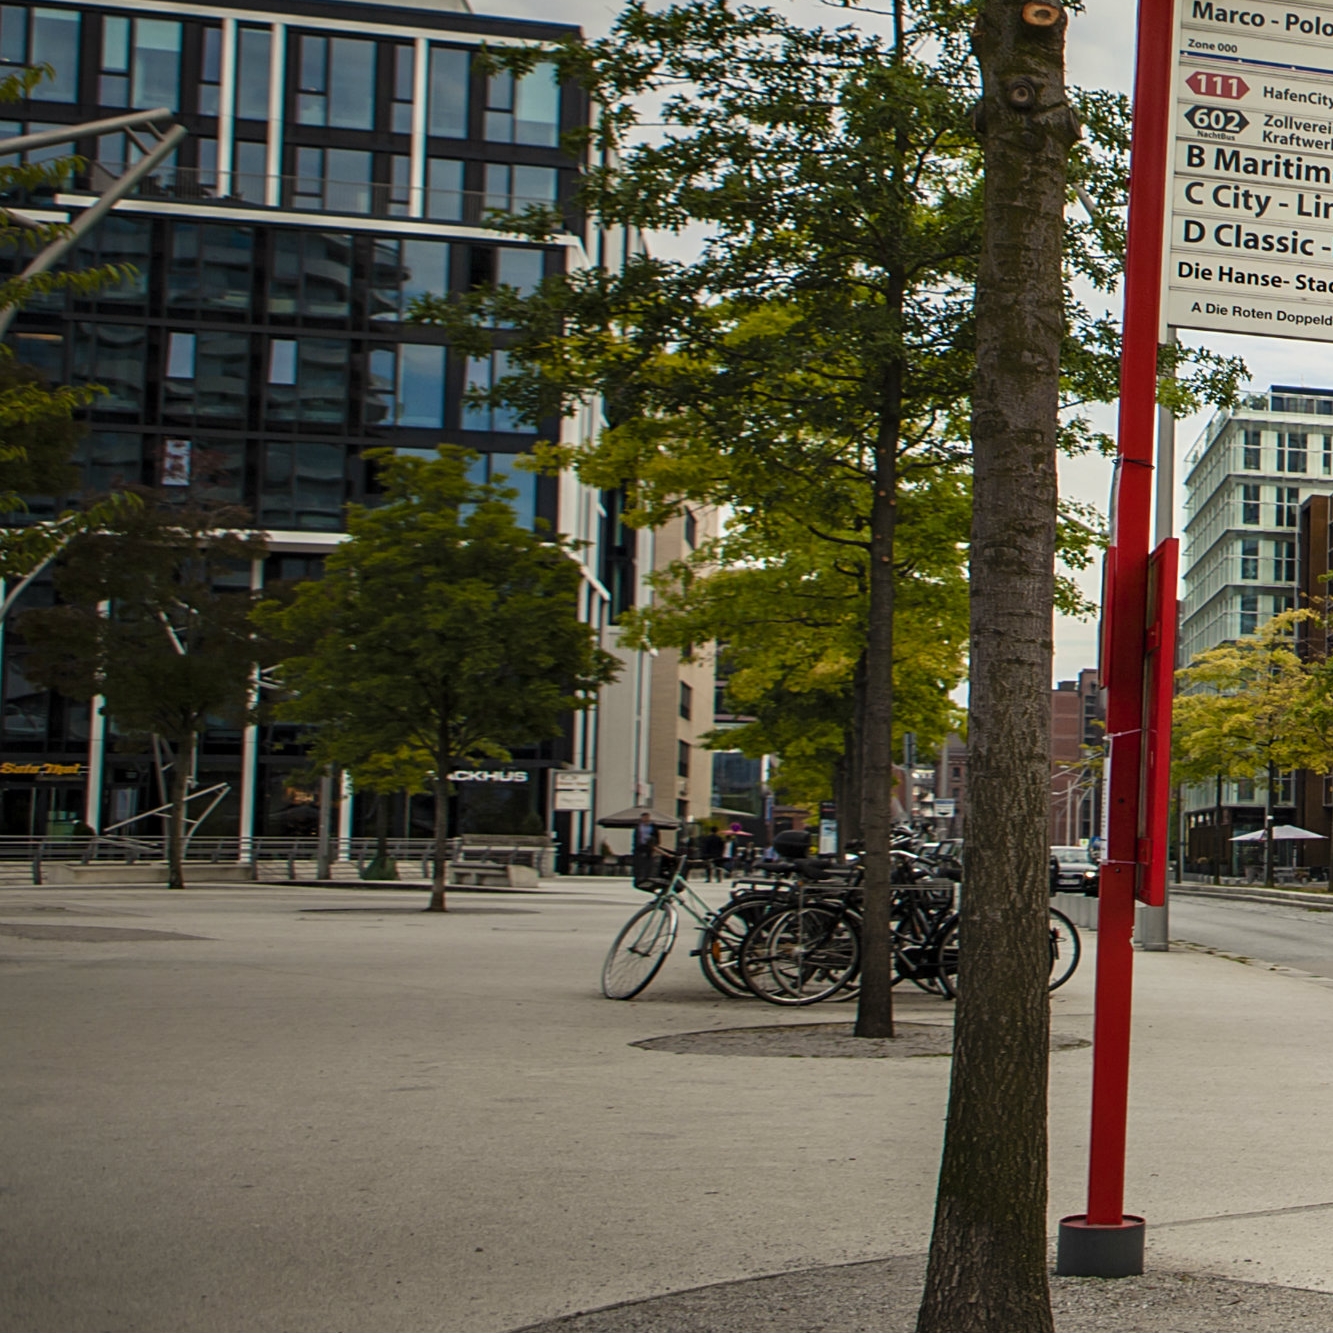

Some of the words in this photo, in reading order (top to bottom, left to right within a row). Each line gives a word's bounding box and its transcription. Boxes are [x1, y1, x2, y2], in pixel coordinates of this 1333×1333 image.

[1192, 0, 1265, 28] Marco
[1188, 39, 1215, 51] Zone
[1217, 42, 1238, 53] 000
[1197, 73, 1239, 97] 111
[1194, 109, 1241, 132] 602
[1197, 130, 1235, 142] NachtBus
[1187, 144, 1205, 168] B
[1185, 181, 1204, 205] C
[1212, 184, 1272, 217] City
[1184, 219, 1205, 243] D
[1214, 223, 1314, 256] Classic
[1178, 262, 1212, 280] Die
[1218, 266, 1290, 288] Hanse-
[1191, 302, 1202, 313] A
[1206, 303, 1228, 315] Die
[1232, 306, 1272, 321] Roten
